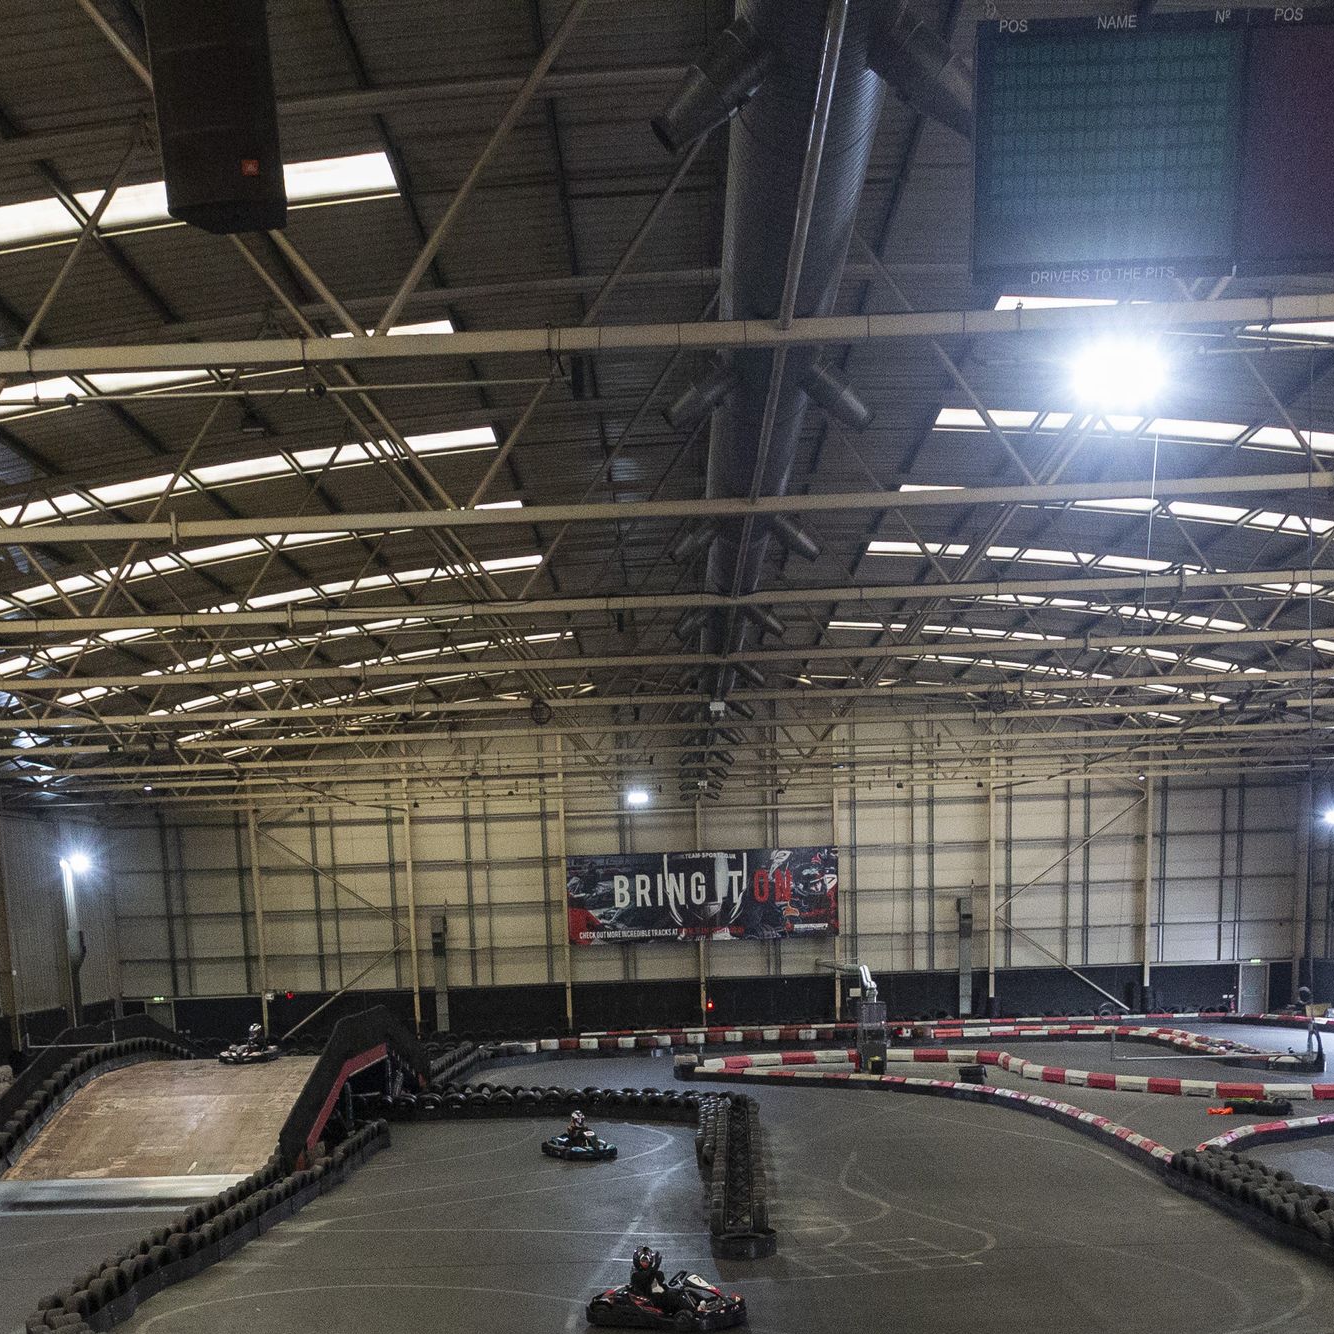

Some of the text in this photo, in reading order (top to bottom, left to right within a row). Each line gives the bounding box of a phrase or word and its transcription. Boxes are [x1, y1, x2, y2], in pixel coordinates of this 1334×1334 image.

[999, 19, 1028, 33] POS
[1097, 14, 1137, 30] NAME
[1274, 7, 1304, 22] POS
[1030, 265, 1175, 284] DRIVERS TO THE PITS
[613, 871, 706, 908] BRING
[753, 868, 793, 903] ON
[579, 931, 596, 940] CHECK
[597, 931, 607, 939] OUT
[607, 930, 622, 938] MORE
[622, 929, 651, 938] INCREDIBLE
[651, 928, 672, 937] TRACKS
[672, 928, 678, 936] AT
